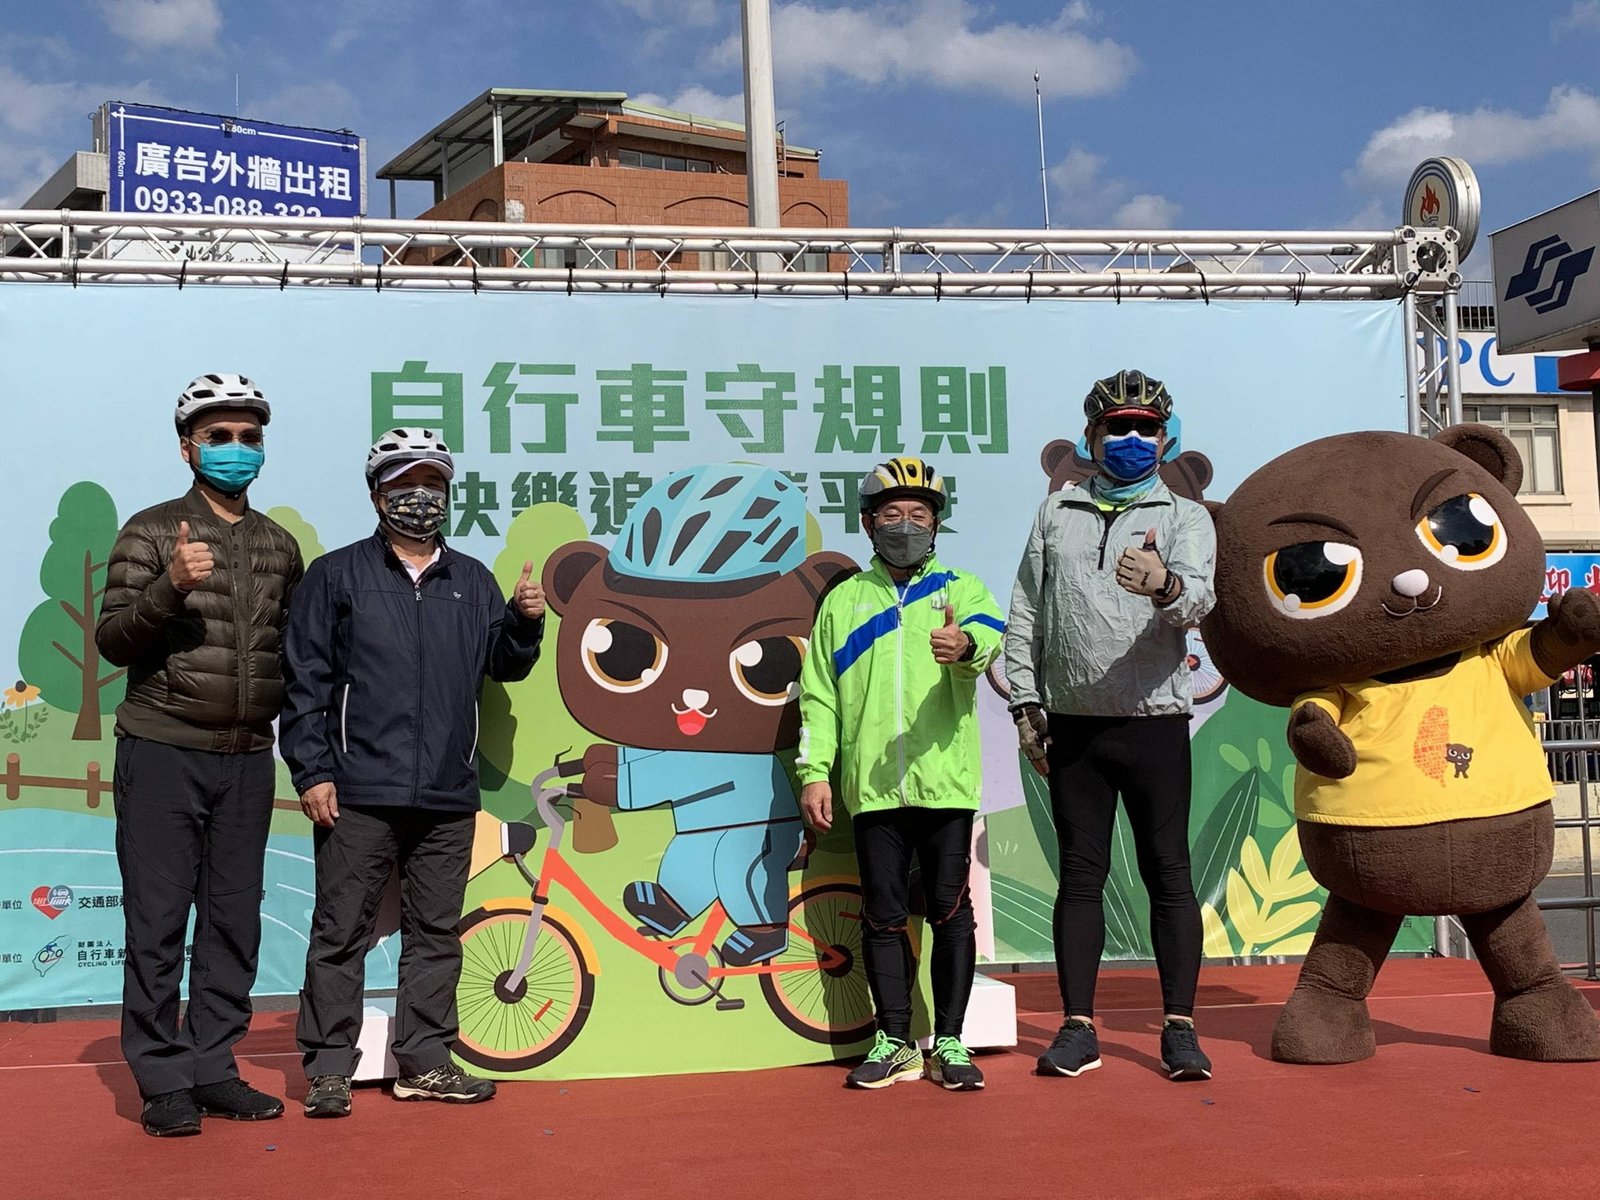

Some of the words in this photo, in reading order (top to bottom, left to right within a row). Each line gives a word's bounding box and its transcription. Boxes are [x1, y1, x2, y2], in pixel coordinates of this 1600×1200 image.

[220, 122, 257, 136] 180cm
[117, 150, 126, 178] 600cm
[134, 141, 352, 202] 廣告外牆出租
[370, 360, 1010, 455] 自行車守規則
[444, 471, 960, 538] 快樂追平
[0, 899, 23, 910] 單位
[0, 953, 23, 964] 單位
[78, 960, 108, 968] CYCLING
